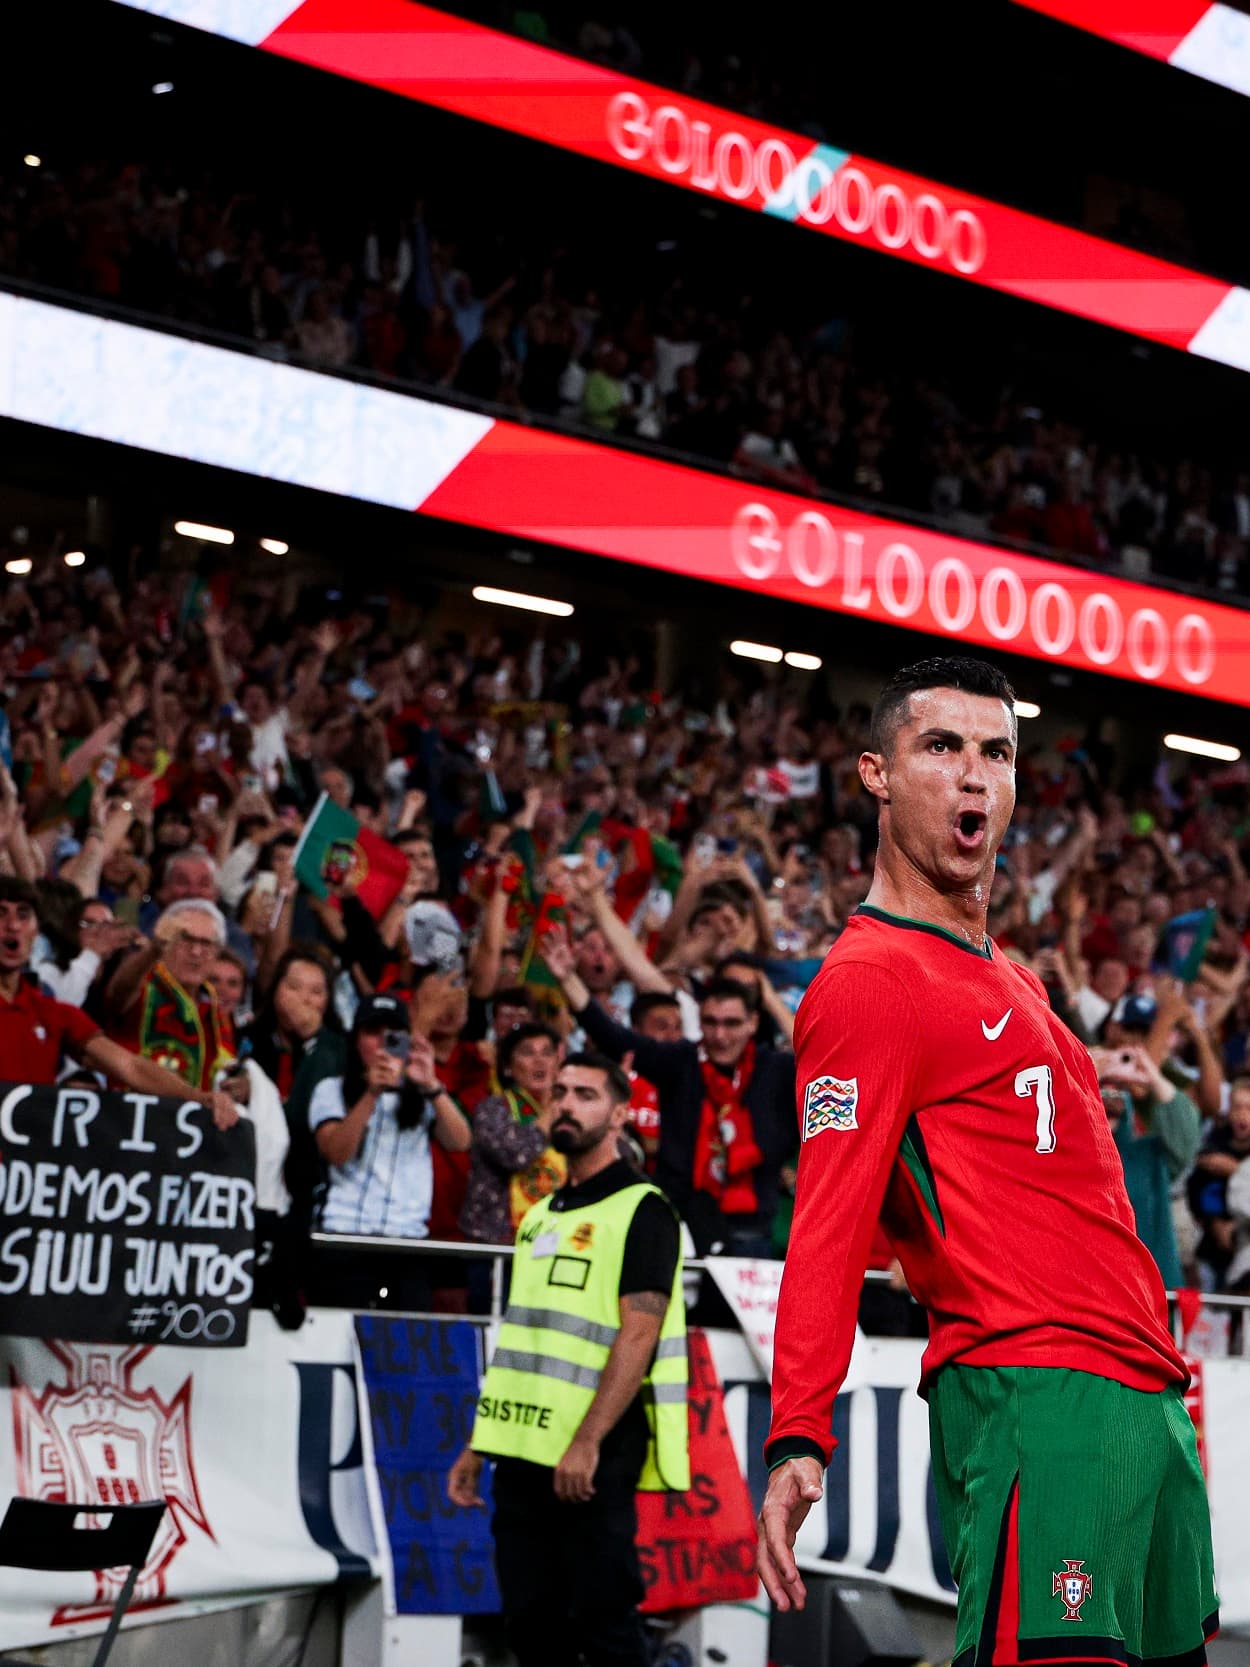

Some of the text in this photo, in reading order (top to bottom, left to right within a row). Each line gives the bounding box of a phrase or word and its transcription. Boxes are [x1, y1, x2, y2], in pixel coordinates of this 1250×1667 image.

[0, 1084, 203, 1158] CRIS
[1014, 1064, 1057, 1154] 7
[0, 1160, 256, 1232] DEMOS FAZER
[124, 1236, 255, 1305] JUNTOS
[127, 1300, 237, 1342] #900
